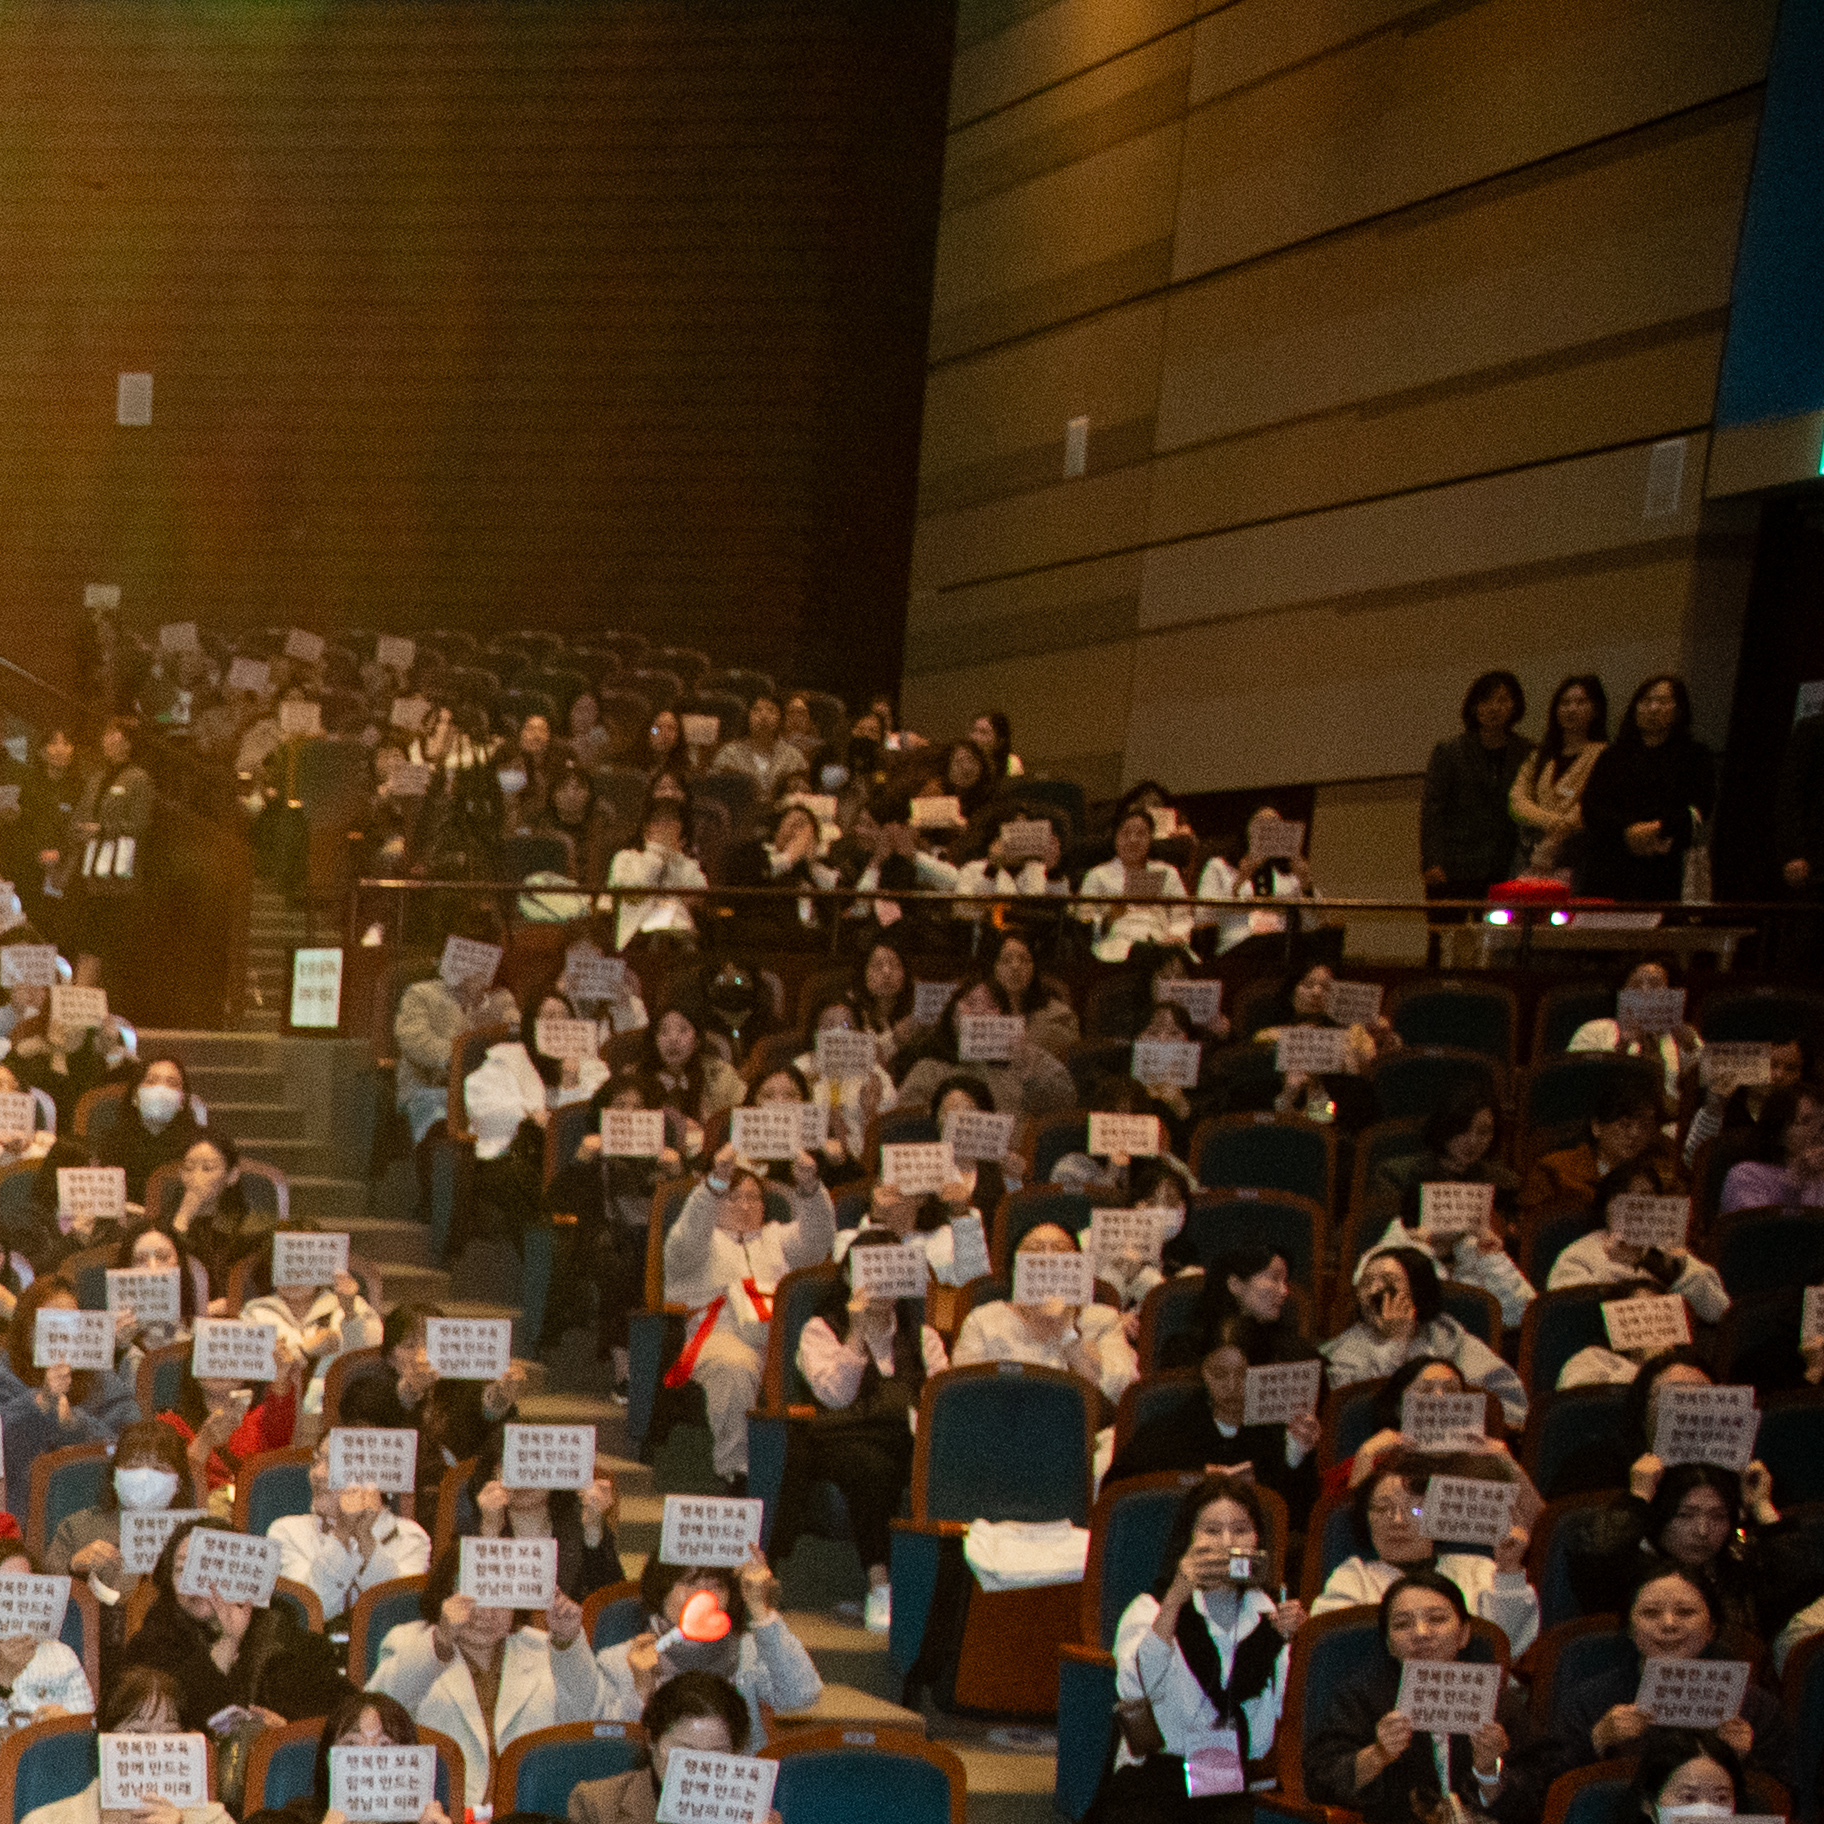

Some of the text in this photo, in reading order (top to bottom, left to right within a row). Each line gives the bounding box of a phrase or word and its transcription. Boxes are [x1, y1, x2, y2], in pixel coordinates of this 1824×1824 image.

[684, 1758, 760, 1783] 행복한 보육
[680, 1779, 756, 1803] 함께 만드는
[676, 1800, 754, 1822] 성남의 미래
